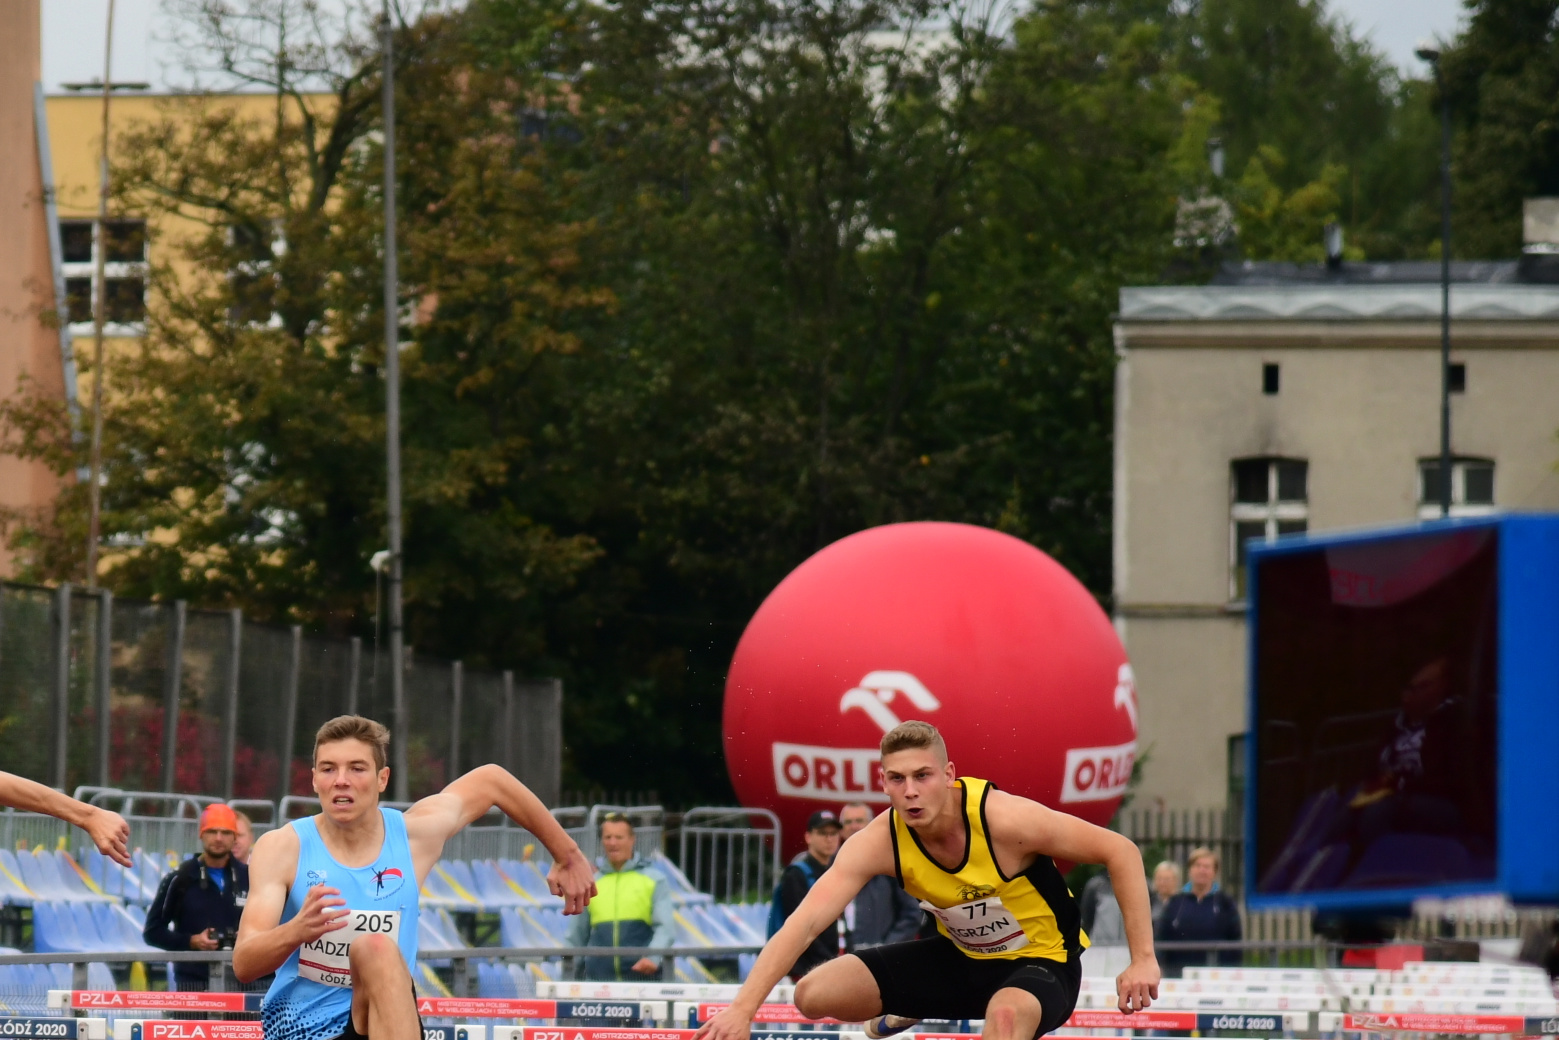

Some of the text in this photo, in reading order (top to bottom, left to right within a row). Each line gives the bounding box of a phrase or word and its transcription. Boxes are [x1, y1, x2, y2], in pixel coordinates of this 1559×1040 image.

[782, 754, 884, 792] ORLE
[1074, 753, 1134, 791] ORL
[962, 902, 987, 919] 77
[354, 914, 393, 933] 205
[950, 917, 1010, 937] GRZYN
[320, 973, 346, 985] ŁÓDŹ
[35, 1024, 67, 1036] 2020
[154, 1025, 206, 1038] PZLA
[210, 1024, 264, 1034] MISTRZOSTW
[219, 1031, 266, 1040] WIELOBOJ
